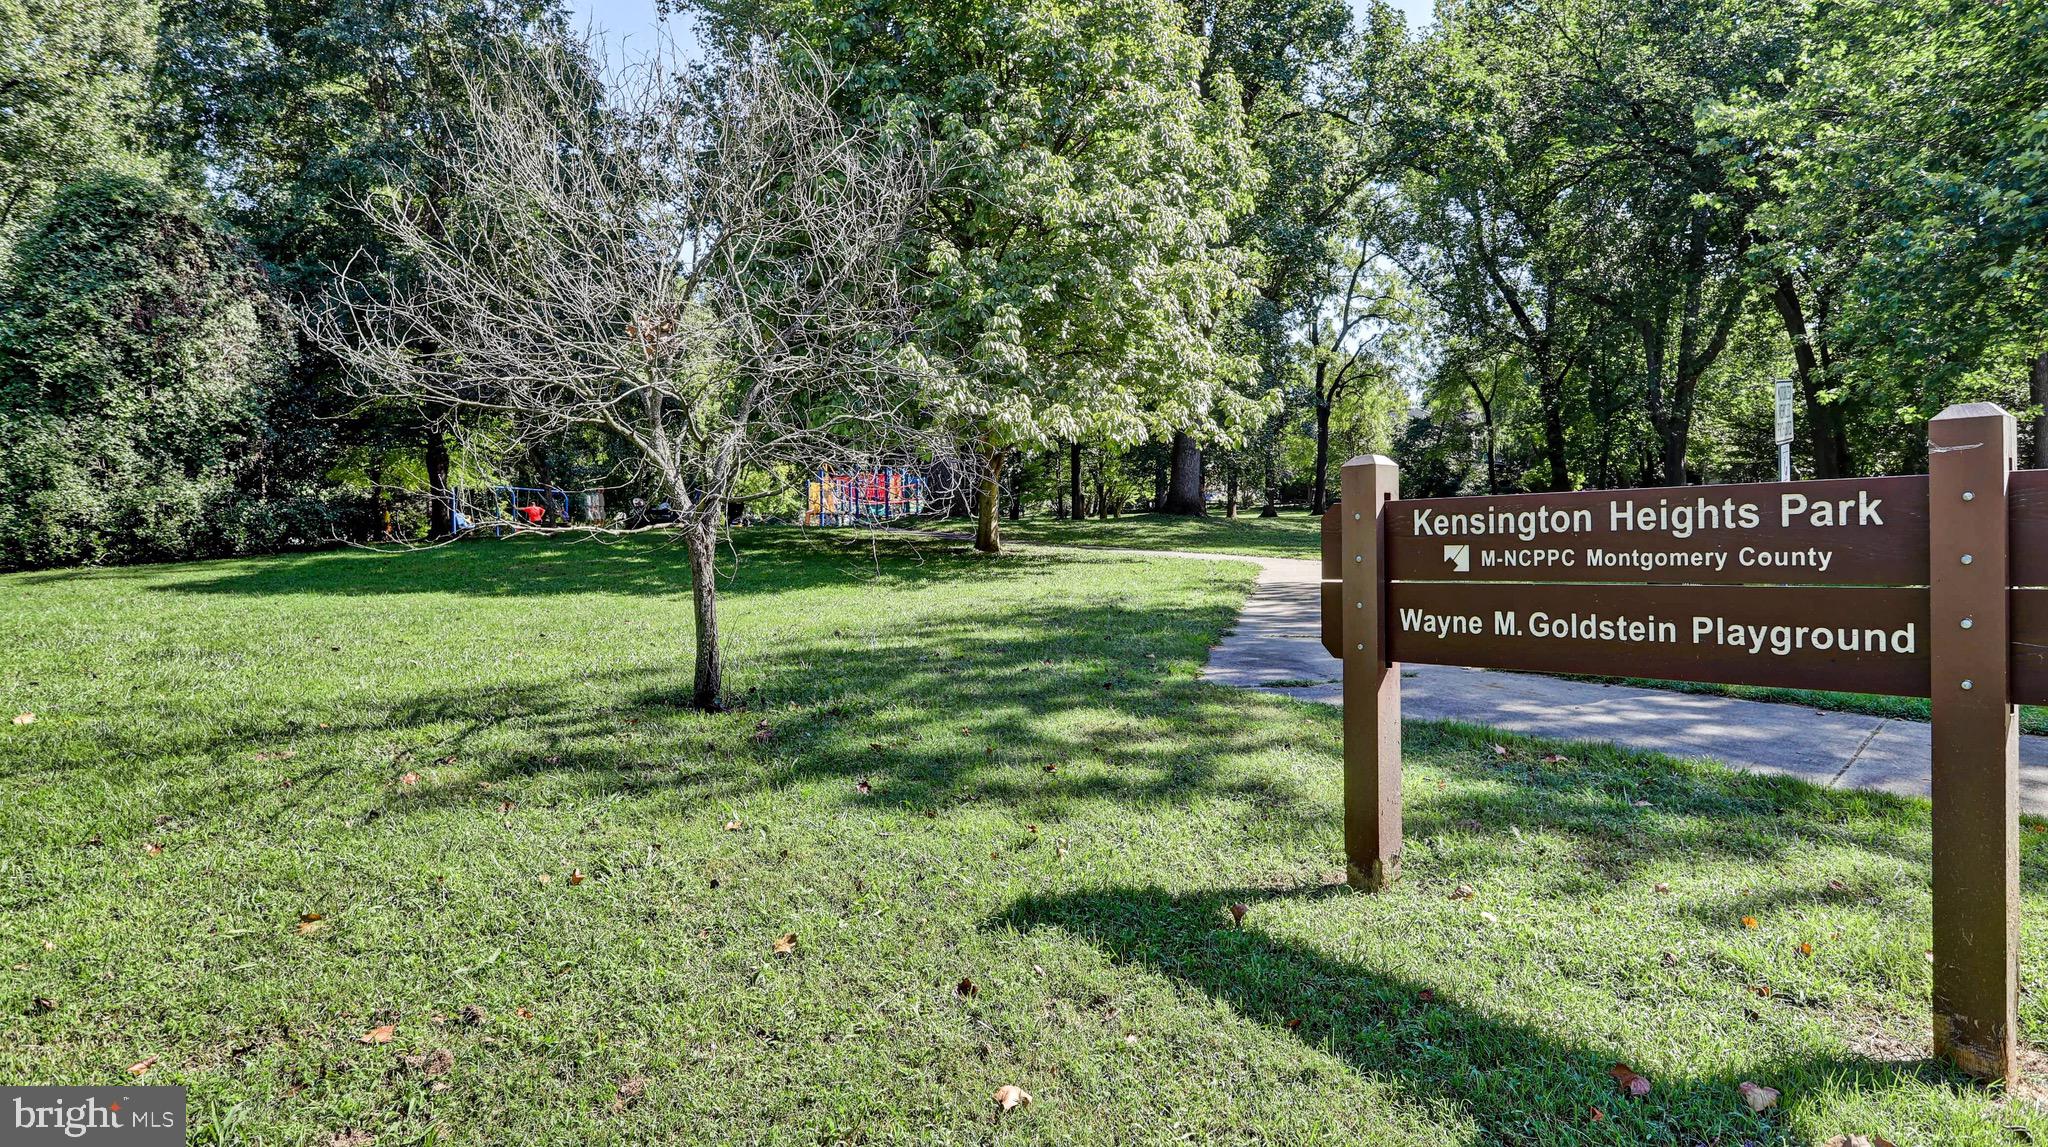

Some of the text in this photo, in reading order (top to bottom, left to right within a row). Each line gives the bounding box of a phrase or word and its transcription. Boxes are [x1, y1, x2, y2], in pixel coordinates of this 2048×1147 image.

[1413, 490, 1884, 542] Kensington Heights Park
[1481, 546, 1833, 572] M-NCPPC Montgomery County
[1399, 608, 1915, 656] Wayne M. Goldstein Playground
